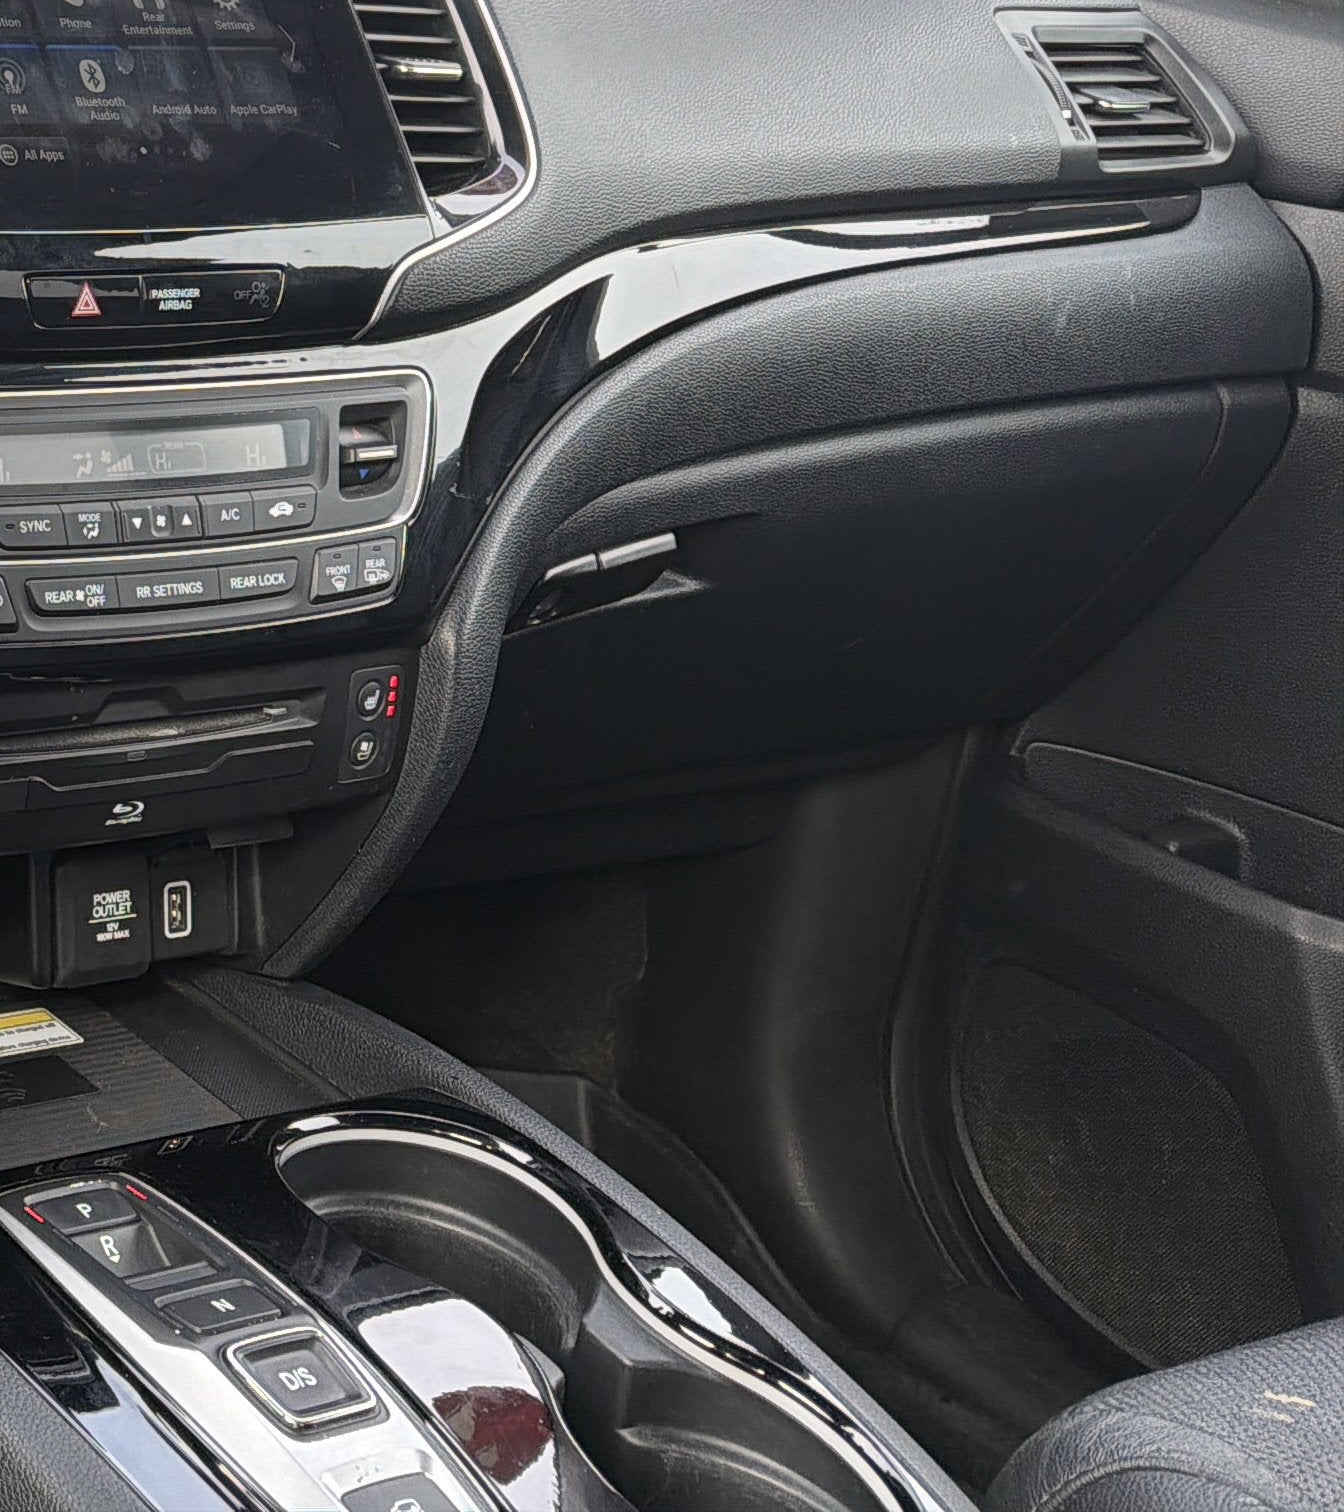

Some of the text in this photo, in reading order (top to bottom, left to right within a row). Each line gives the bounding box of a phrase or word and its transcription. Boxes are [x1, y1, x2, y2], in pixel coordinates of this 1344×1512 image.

[59, 17, 92, 29] Phone
[142, 11, 165, 23] Rear
[121, 24, 193, 36] Entertainment
[214, 19, 256, 32] Settings
[5, 84, 22, 95] FM
[75, 96, 126, 108] Bluetooth
[11, 104, 28, 115] FM
[90, 110, 120, 121] Audio
[152, 104, 217, 115] Android Auto
[230, 104, 298, 117] Apple CarPlay
[24, 149, 65, 162] All Apps
[151, 288, 201, 299] PASSENGER
[233, 290, 252, 301] OFF
[158, 299, 193, 311] AIRBAG
[78, 513, 102, 524] MODE
[220, 508, 241, 522] A/C
[19, 519, 51, 534] SYNC
[365, 557, 386, 568] REAR
[325, 564, 352, 577] FRONT
[230, 571, 286, 589] REAR LOCK
[85, 583, 105, 595] ON/
[136, 581, 204, 599] RR SETTINGS
[44, 590, 74, 605] REAR
[86, 595, 107, 608] OFF
[93, 889, 131, 906] POWER
[92, 901, 133, 918] OUTLET
[113, 929, 131, 940] MAX
[75, 1202, 93, 1219] P
[99, 1234, 117, 1256] R
[210, 1298, 237, 1314] N
[278, 1364, 318, 1390] D/S
